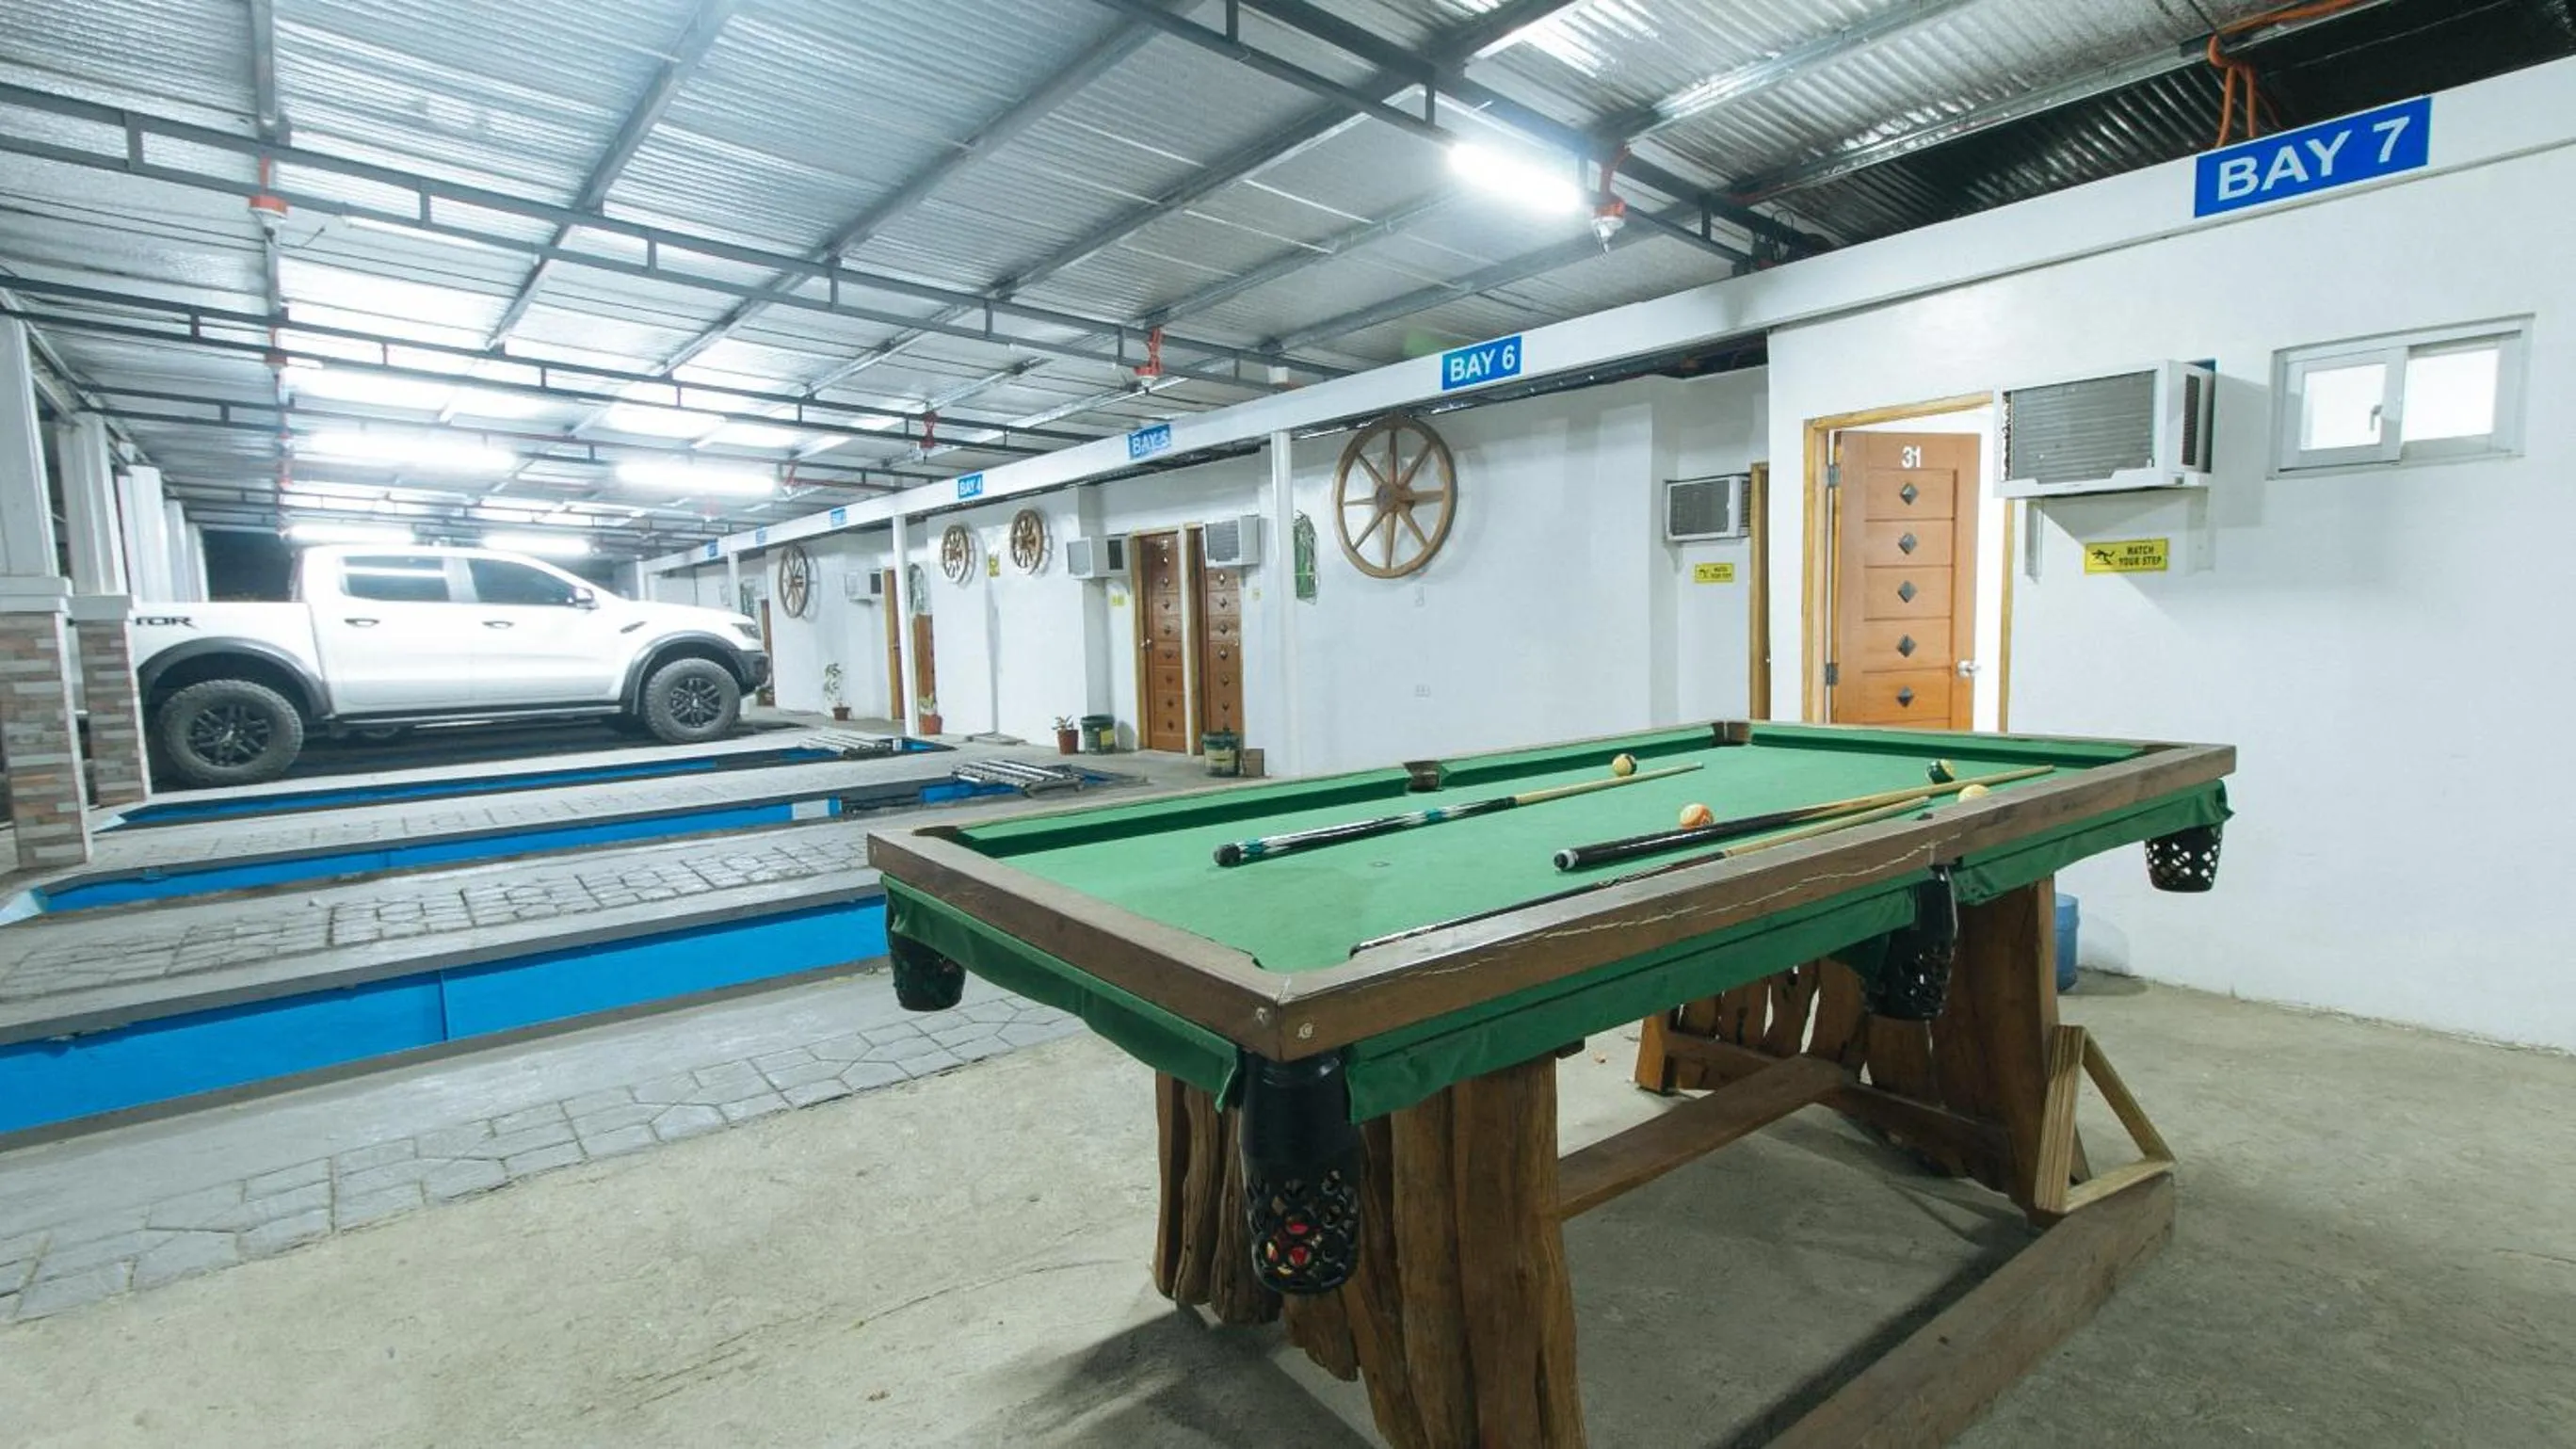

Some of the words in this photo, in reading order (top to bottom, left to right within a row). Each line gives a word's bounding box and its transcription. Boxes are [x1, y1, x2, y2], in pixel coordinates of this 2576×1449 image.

[2217, 129, 2353, 201] BAY
[2372, 116, 2410, 164] 7
[1450, 348, 1496, 382] BAY
[1502, 344, 1515, 370] 6
[1133, 432, 1158, 455] BAY
[1901, 445, 1922, 469] 31
[2118, 556, 2140, 566] YOUR
[2142, 555, 2162, 565] STEP
[2127, 545, 2154, 555] WATCH
[136, 617, 199, 630] TOR
